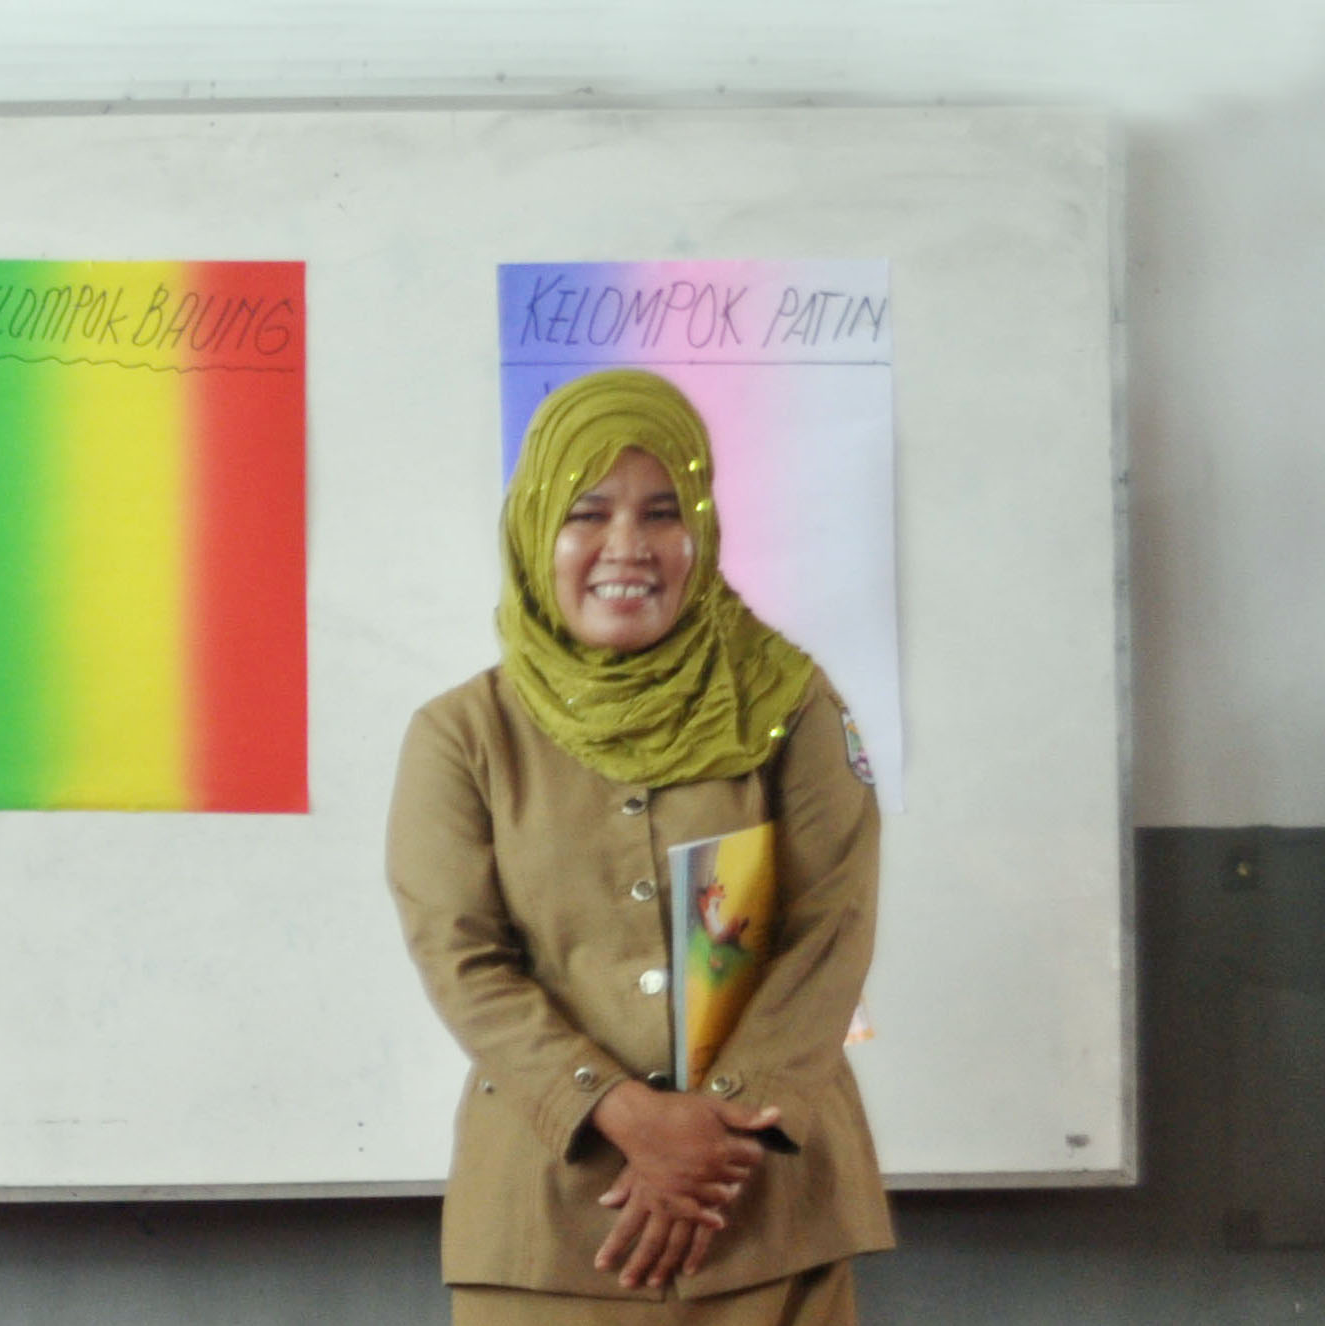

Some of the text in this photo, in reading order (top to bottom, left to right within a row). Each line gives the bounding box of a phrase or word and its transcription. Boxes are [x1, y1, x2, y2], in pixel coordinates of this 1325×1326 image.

[131, 283, 294, 356] BAUNG
[520, 274, 887, 349] KELOMPOK PATIN
